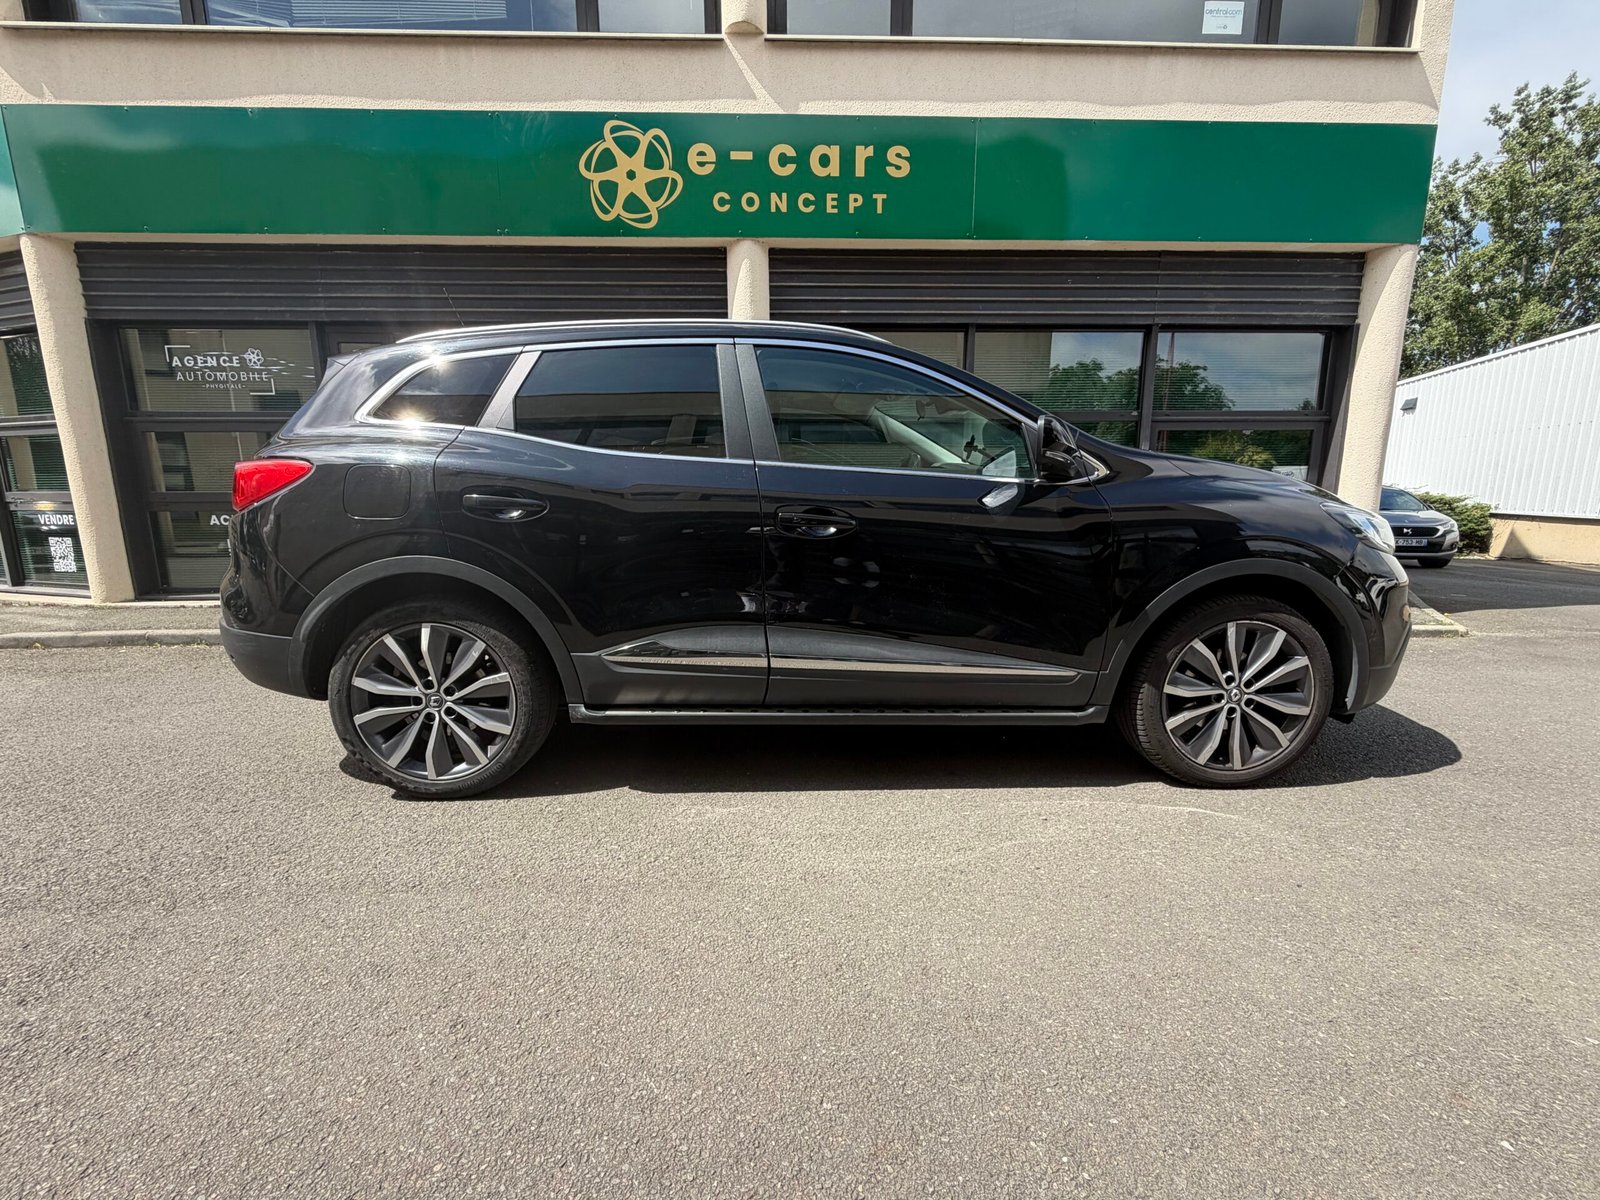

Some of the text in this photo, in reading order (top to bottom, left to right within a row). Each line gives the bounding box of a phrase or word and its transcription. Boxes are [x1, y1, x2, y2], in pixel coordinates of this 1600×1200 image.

[686, 142, 911, 178] e-cars
[712, 191, 887, 214] CONCEPT
[172, 356, 240, 367] AGENCE
[176, 371, 269, 381] AUTOMOBILE
[38, 514, 75, 525] VENDRE
[210, 514, 234, 525] AC
